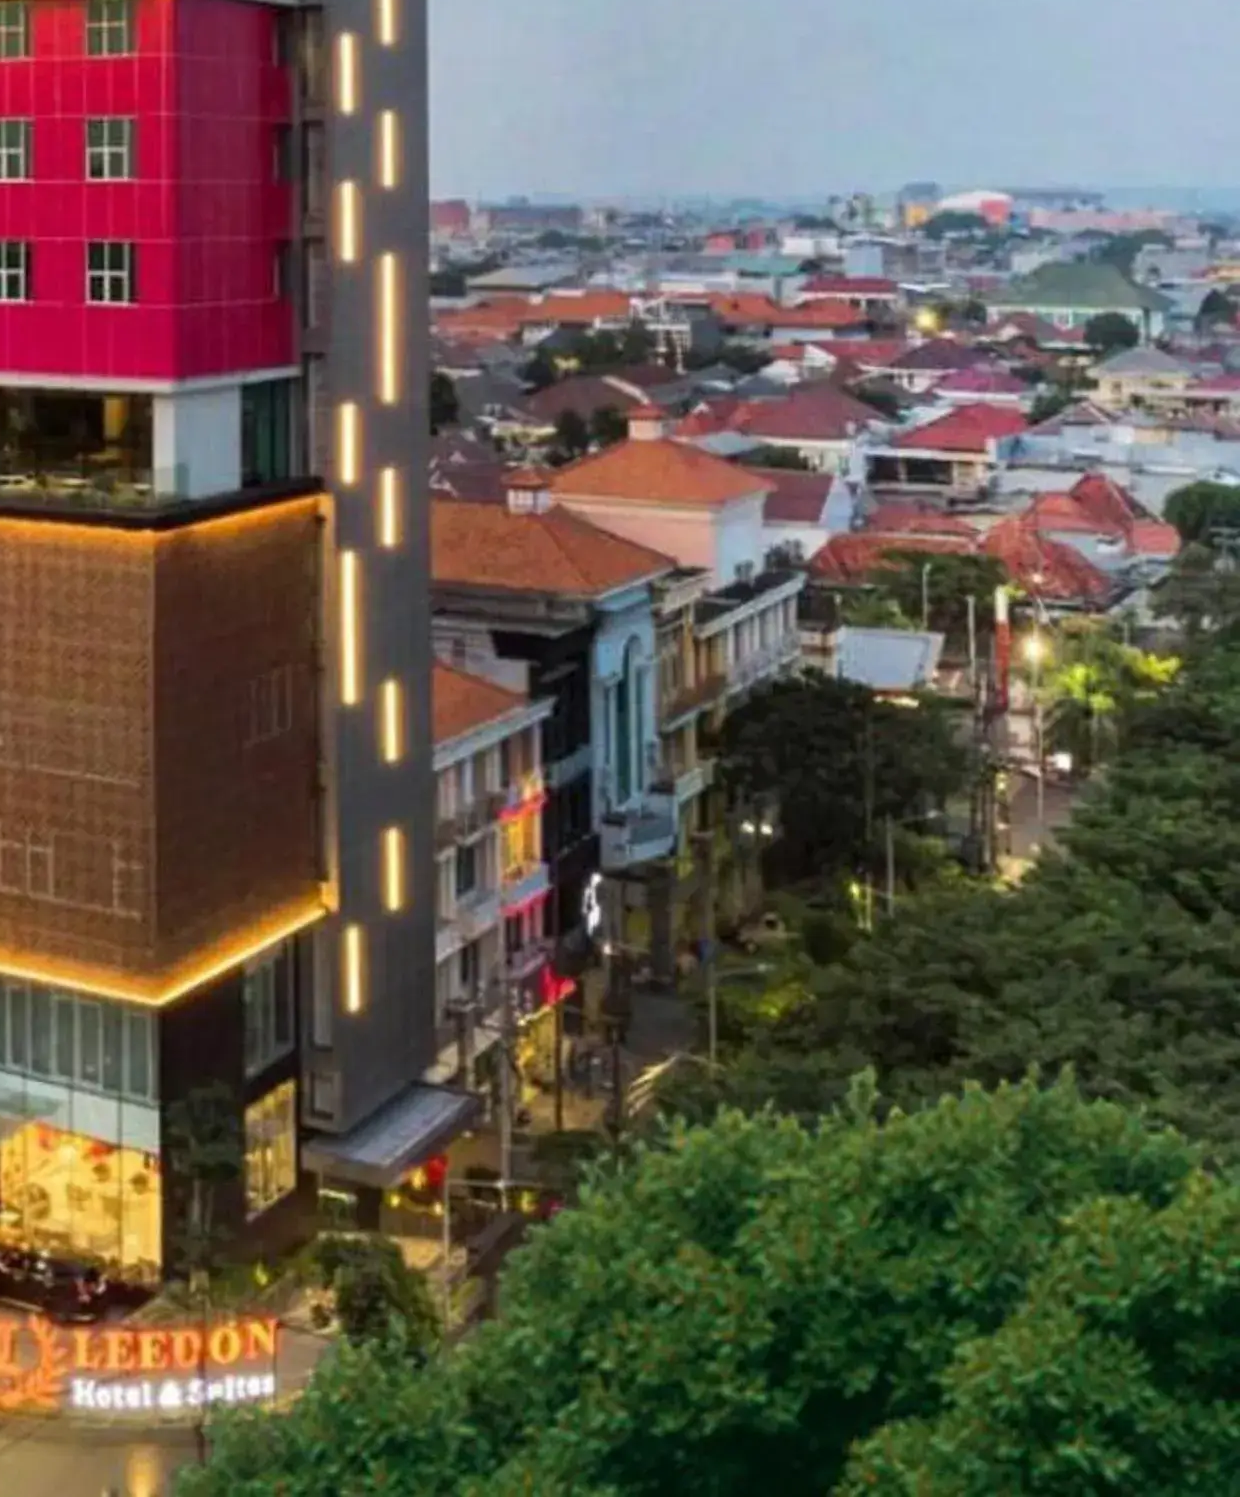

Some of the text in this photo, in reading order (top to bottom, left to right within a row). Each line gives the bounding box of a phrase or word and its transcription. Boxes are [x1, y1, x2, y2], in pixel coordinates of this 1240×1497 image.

[73, 1318, 277, 1371] LEEDON
[72, 1378, 152, 1407] Hotel
[187, 1372, 275, 1406] Suites
